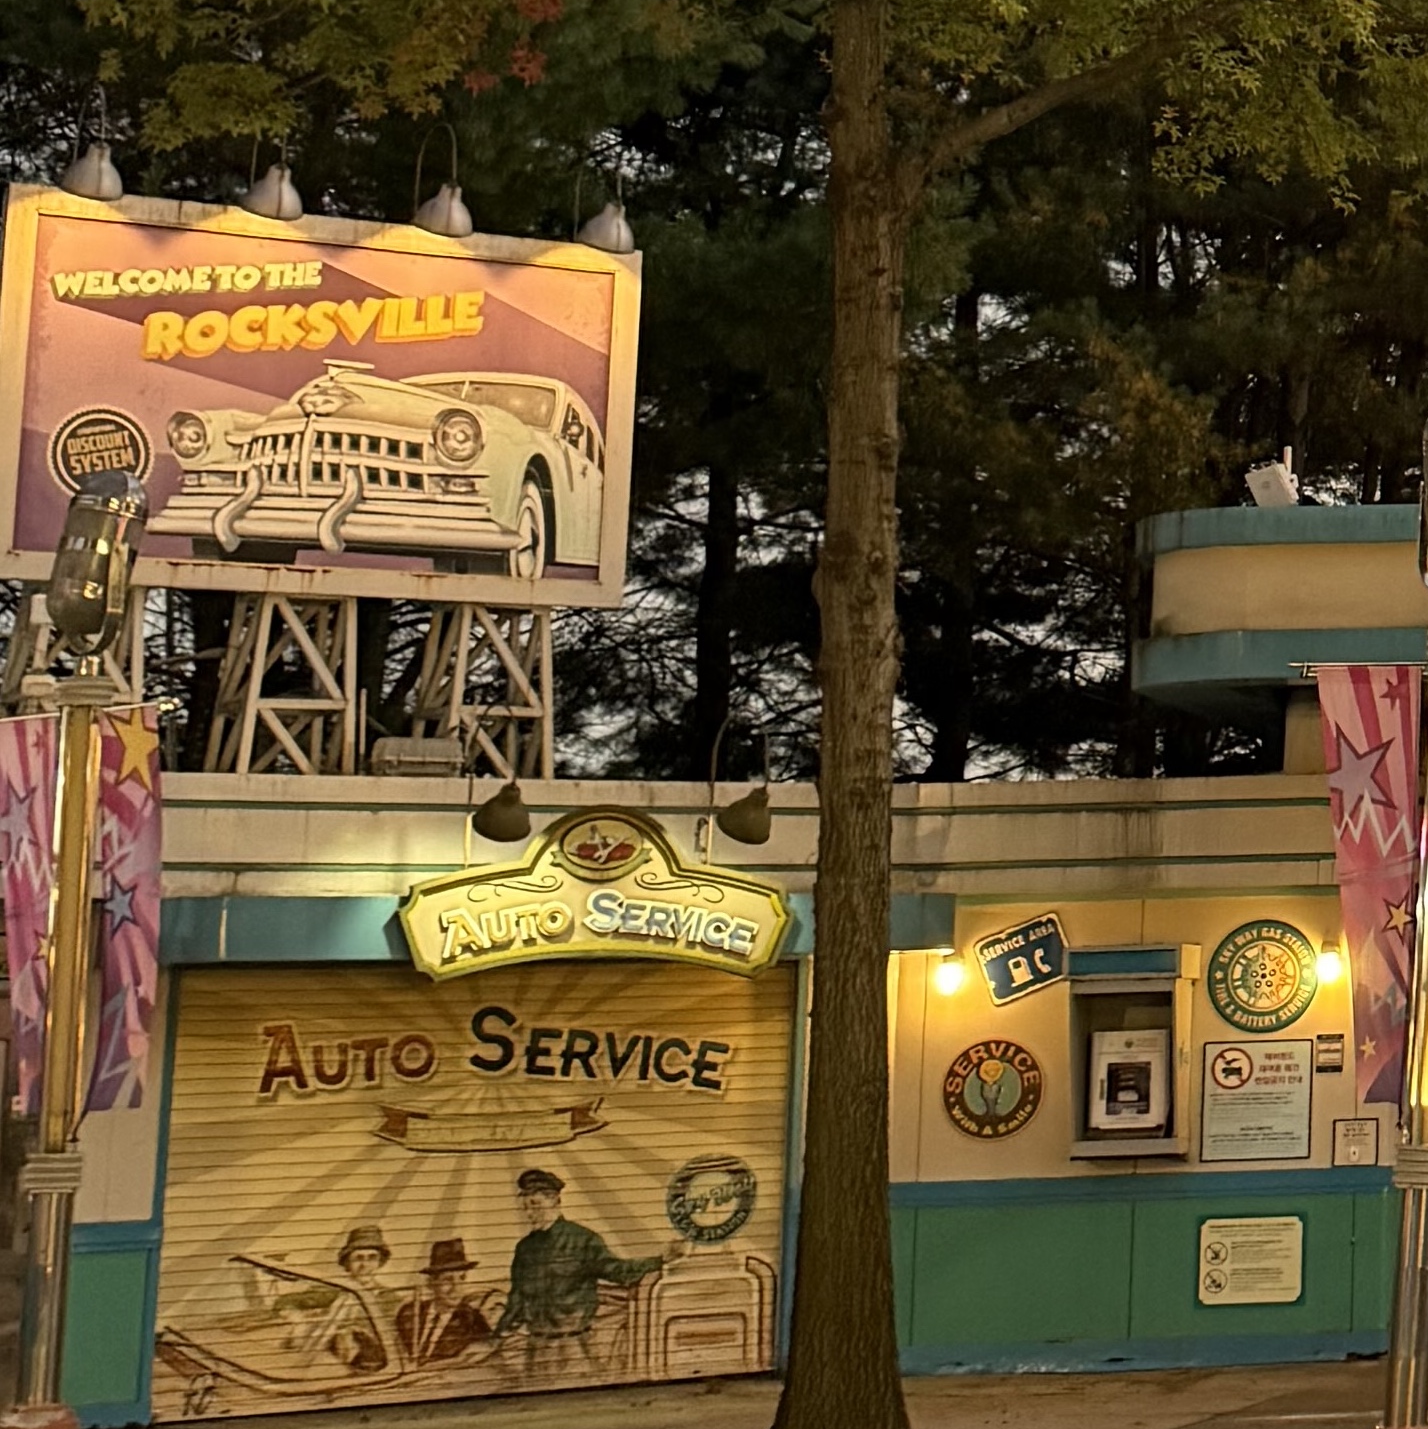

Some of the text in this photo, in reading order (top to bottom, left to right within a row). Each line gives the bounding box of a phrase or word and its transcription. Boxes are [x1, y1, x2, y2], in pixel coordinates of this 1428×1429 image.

[52, 261, 323, 299] WELCOME TO THE
[142, 290, 486, 361] ROCKSVILLE
[67, 430, 130, 455] DISCOUNT
[69, 447, 136, 476] SYSTEM
[440, 888, 760, 960] AUTO SERVICE
[982, 923, 1056, 962] SERVICE AREA
[1261, 927, 1283, 940] GAS
[1232, 1010, 1277, 1028] BATTERY
[1279, 983, 1313, 1021] SERVICE
[259, 1005, 731, 1094] AUTO SERVICE
[945, 1042, 1041, 1094] SERVICE
[981, 1125, 993, 1135] A
